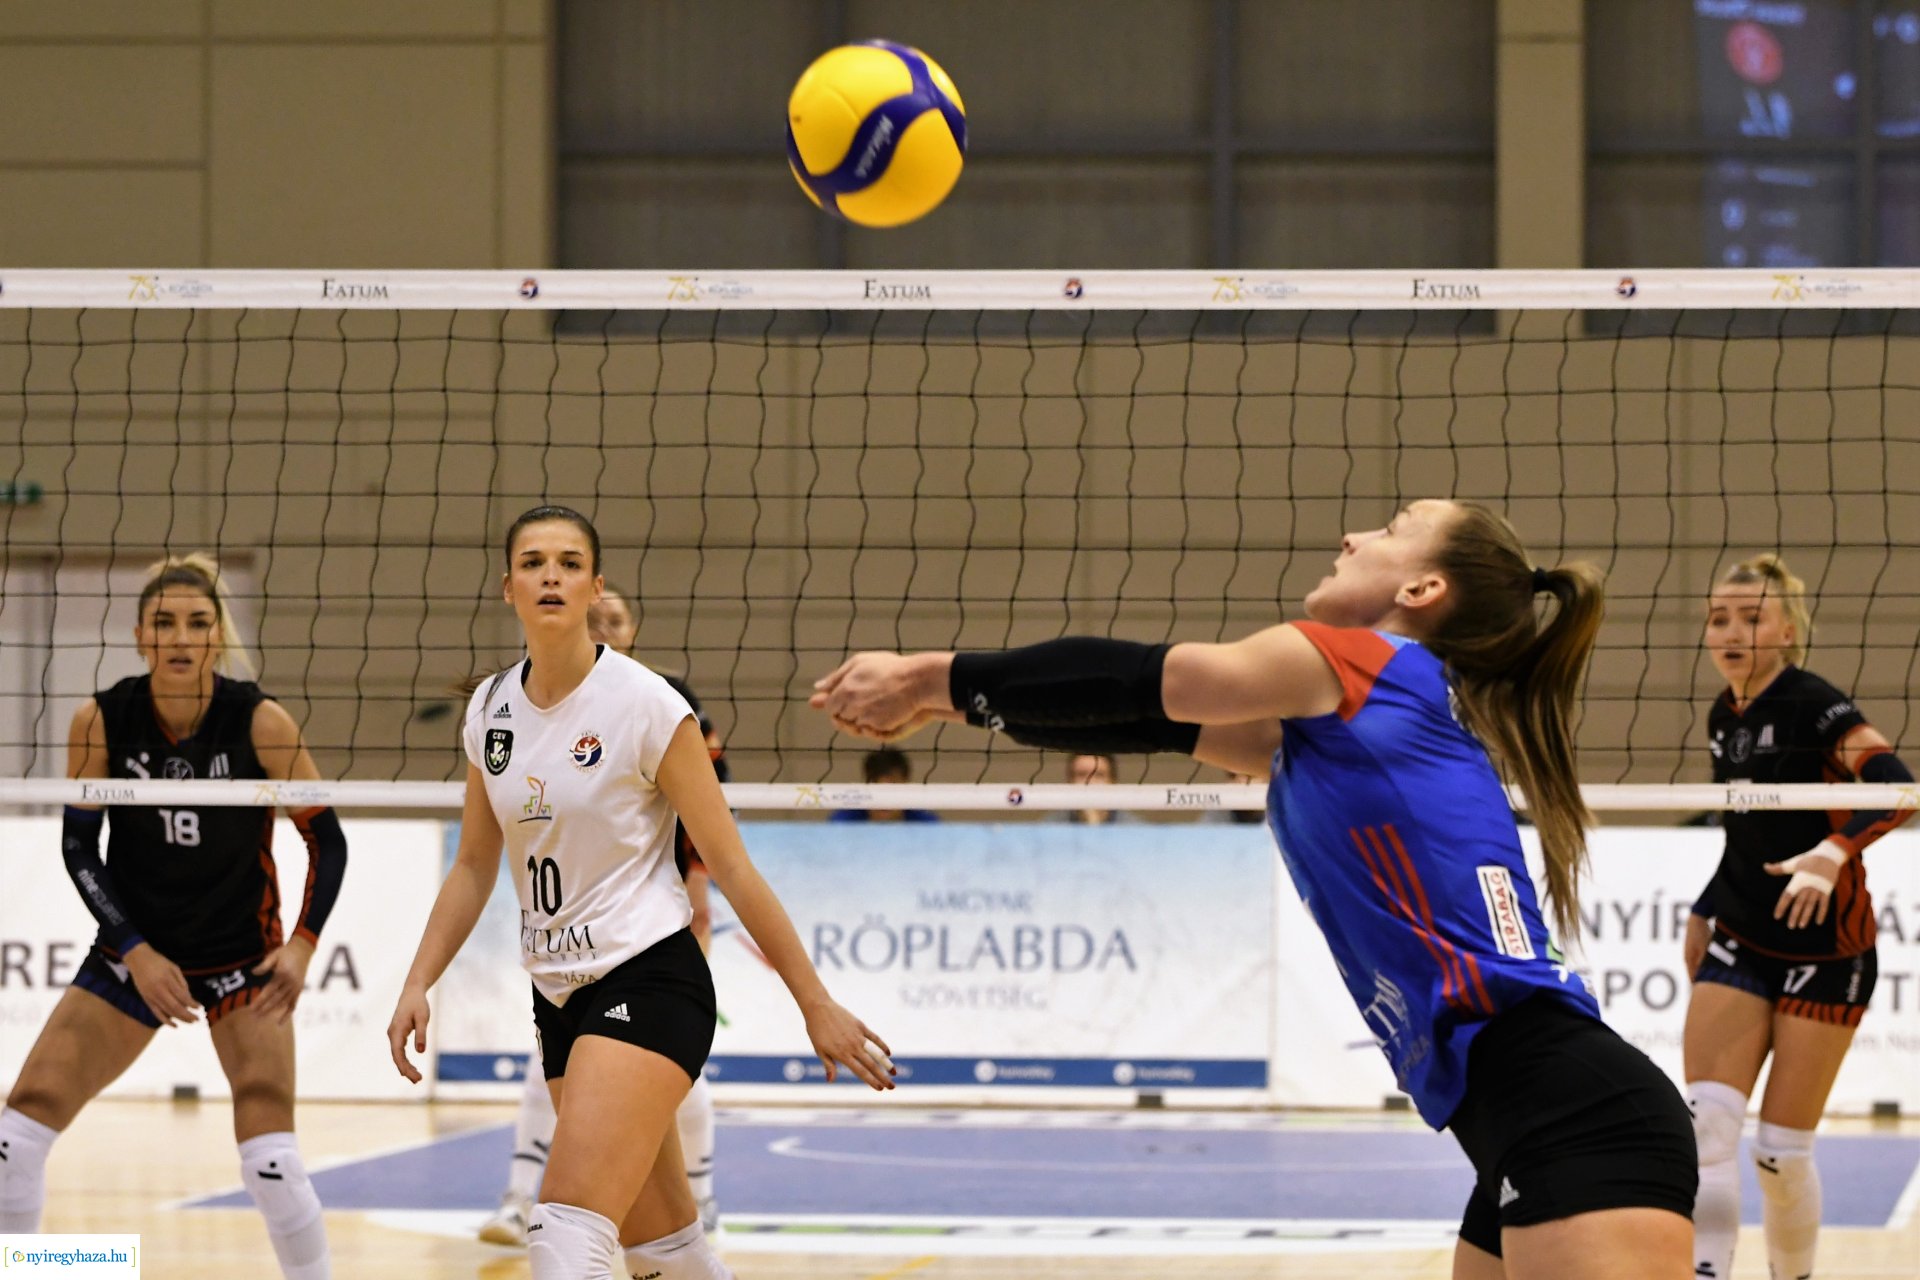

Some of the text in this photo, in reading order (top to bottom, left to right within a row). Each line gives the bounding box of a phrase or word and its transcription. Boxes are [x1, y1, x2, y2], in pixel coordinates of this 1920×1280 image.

[321, 278, 389, 299] FATUM
[863, 279, 931, 300] FATUM
[1411, 278, 1481, 300] FATUM
[492, 731, 507, 740] CEV
[82, 783, 135, 801] FATUM
[1166, 788, 1221, 806] FATUM
[1725, 788, 1781, 806] FATUM
[158, 808, 201, 847] 18
[527, 855, 562, 917] 10
[1490, 871, 1524, 955] STRABAG
[812, 914, 1138, 972] RÖPLABDA
[1783, 965, 1817, 994] 17
[605, 1011, 631, 1023] adidas
